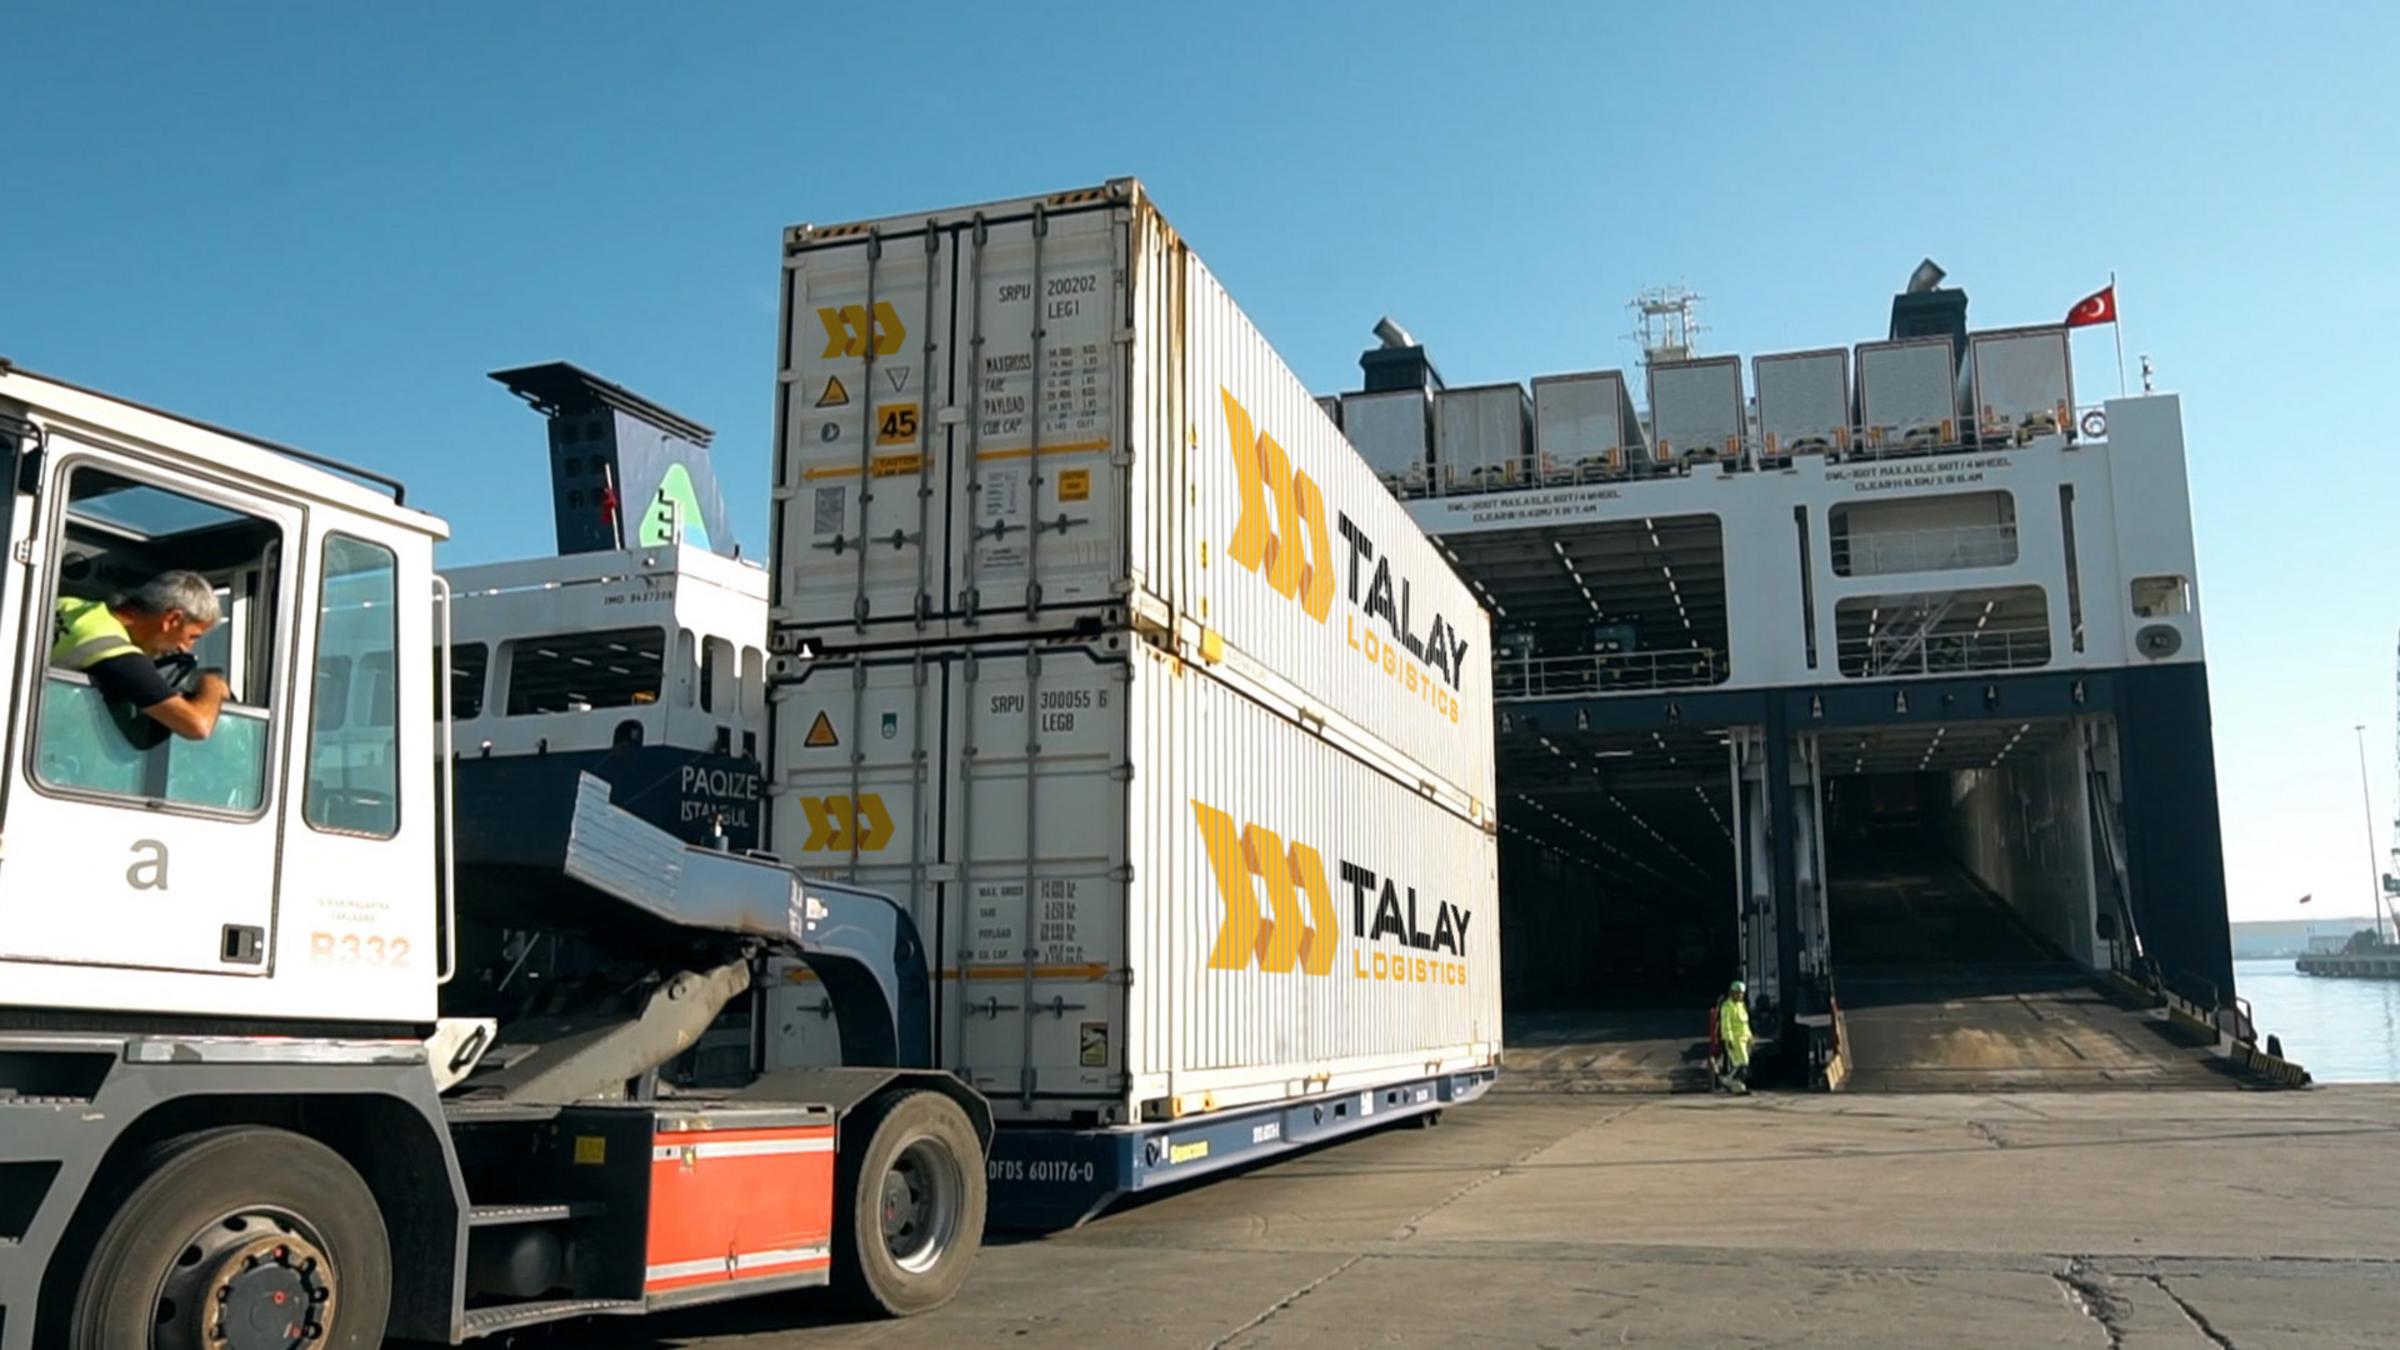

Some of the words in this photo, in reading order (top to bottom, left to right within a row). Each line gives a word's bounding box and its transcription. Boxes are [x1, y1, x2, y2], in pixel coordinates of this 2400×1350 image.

[999, 283, 1031, 303] SRPU
[1047, 275, 1096, 297] 200202
[881, 410, 917, 438] 45
[604, 594, 625, 606] IMO
[1338, 508, 1468, 692] TALAY
[1347, 612, 1458, 724] LOGISTICS
[991, 694, 1025, 714] SRPU
[1041, 689, 1090, 709] 300055
[681, 765, 759, 800] PAQIZE
[126, 838, 169, 891] a
[1340, 859, 1471, 957] TALAY
[1354, 949, 1467, 985] LOGISTICS
[988, 1160, 1024, 1180] DFDS
[1029, 1161, 1095, 1182] 601176-0
